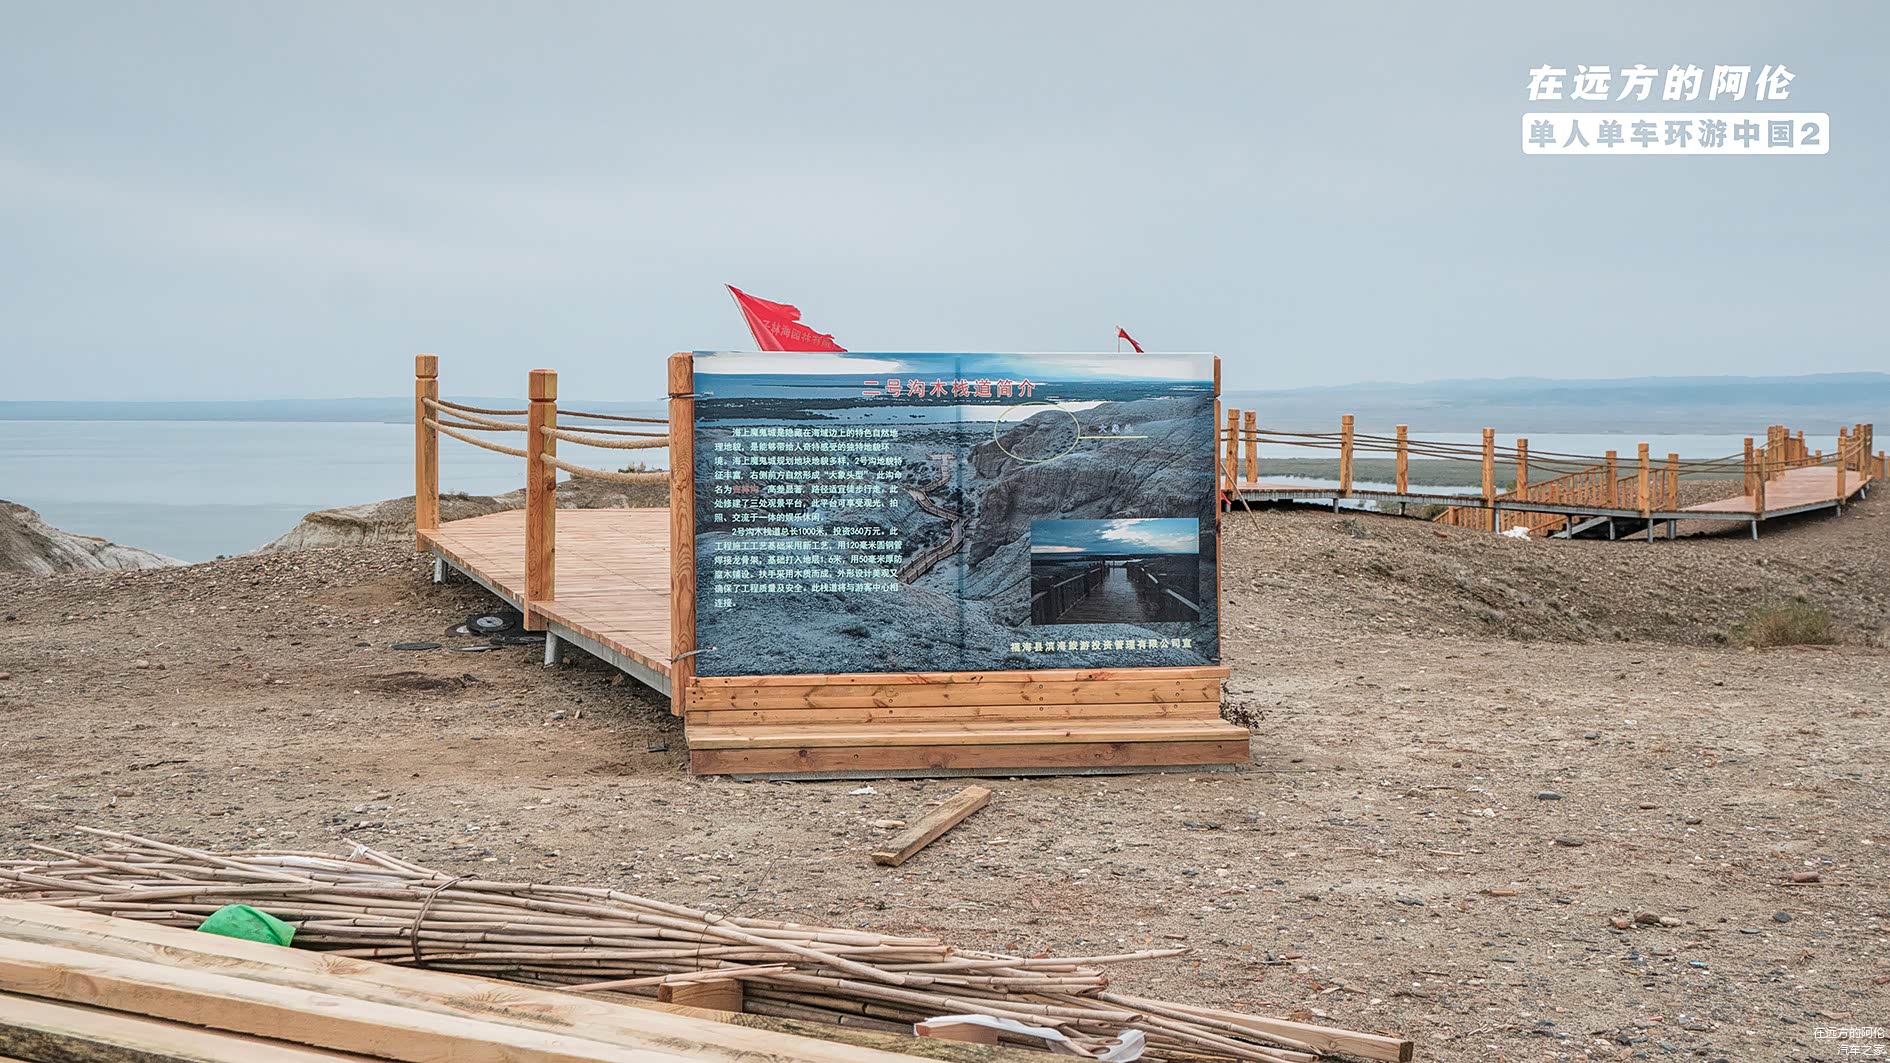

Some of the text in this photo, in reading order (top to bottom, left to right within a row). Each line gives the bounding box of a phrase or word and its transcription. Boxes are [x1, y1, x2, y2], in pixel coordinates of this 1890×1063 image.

[862, 378, 1037, 399] 二号沟木栈道简介
